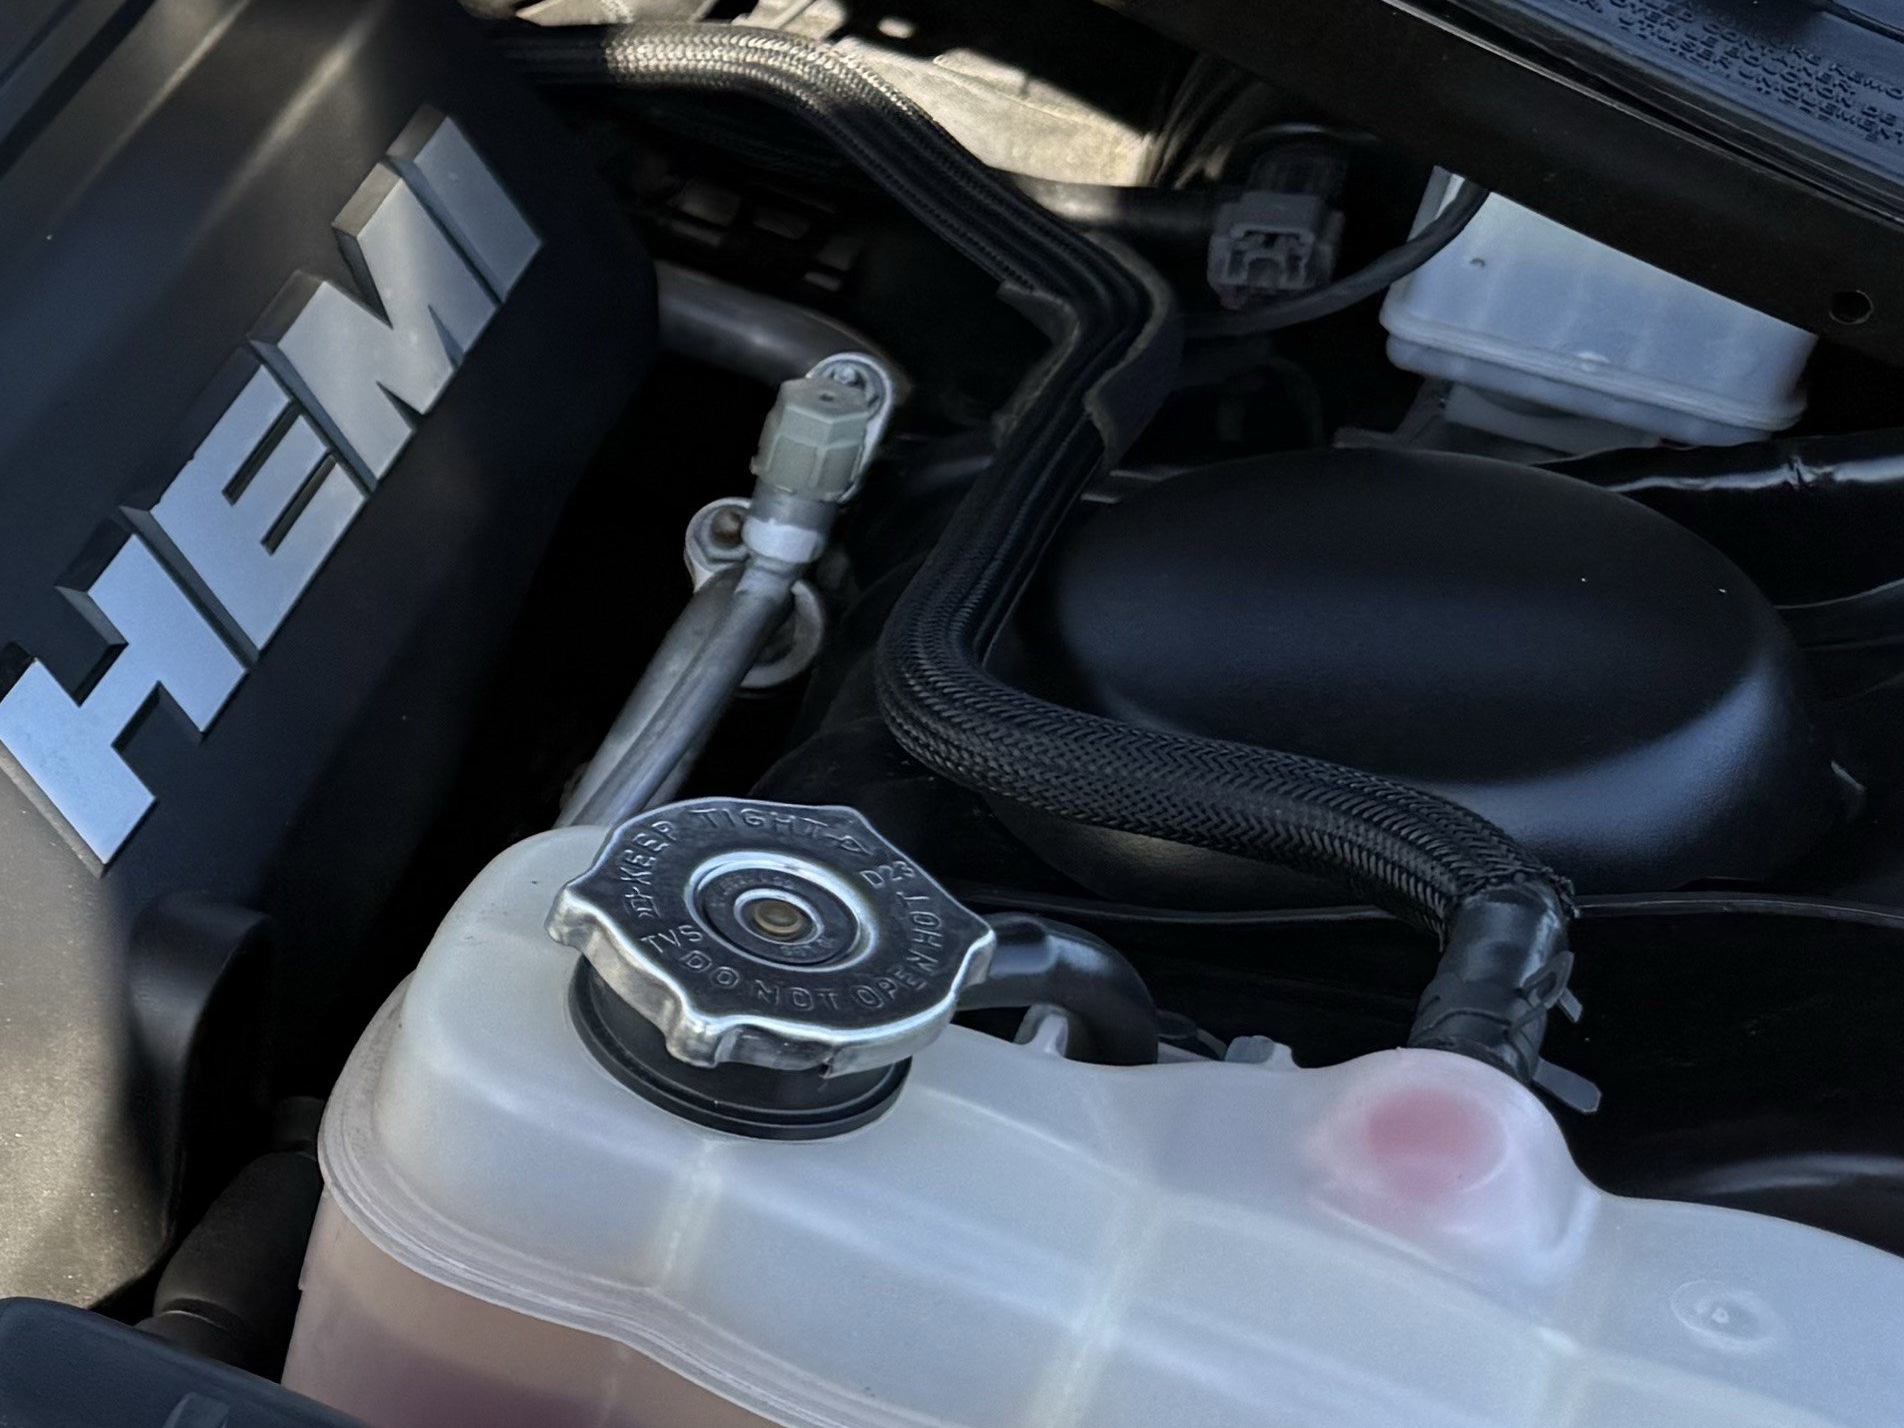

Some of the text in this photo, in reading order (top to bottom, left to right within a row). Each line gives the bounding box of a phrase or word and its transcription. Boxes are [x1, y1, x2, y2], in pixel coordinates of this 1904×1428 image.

[619, 807, 829, 887] KEEP TIGHT
[640, 924, 704, 955] TVS
[680, 949, 741, 989] DO
[748, 977, 841, 1013] NOT
[848, 948, 940, 1010] OPEN
[895, 890, 944, 948] HOT
